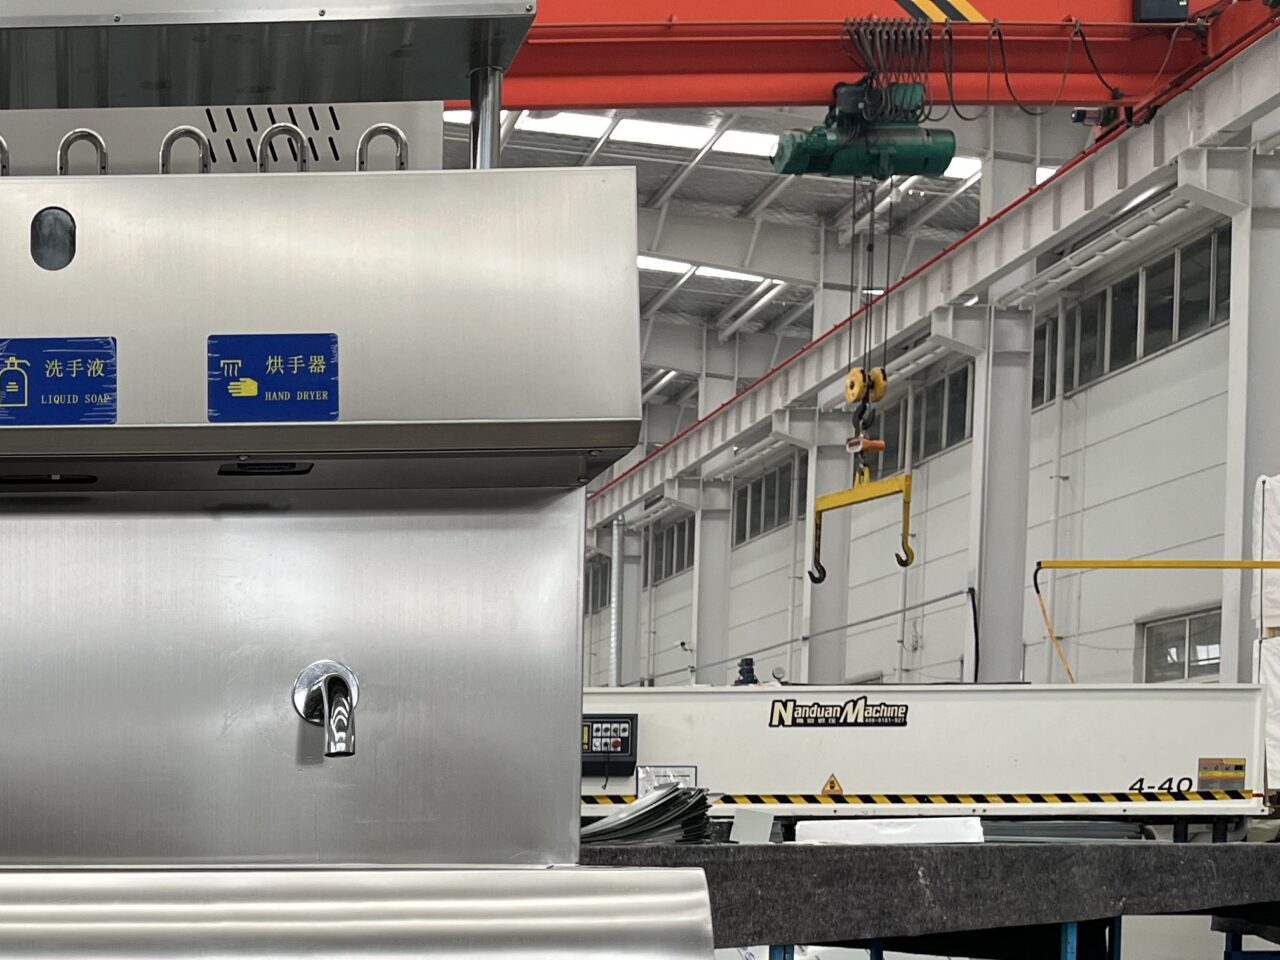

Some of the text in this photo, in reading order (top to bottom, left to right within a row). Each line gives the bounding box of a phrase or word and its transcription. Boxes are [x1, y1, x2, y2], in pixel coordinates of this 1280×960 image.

[44, 358, 105, 378] 洗手液
[265, 355, 327, 375] 烘手器
[41, 393, 110, 405] LIQUID SOAP
[265, 390, 328, 401] HAND DRYER
[770, 697, 906, 726] Nanduan Machine
[1128, 777, 1193, 793] 4-40
